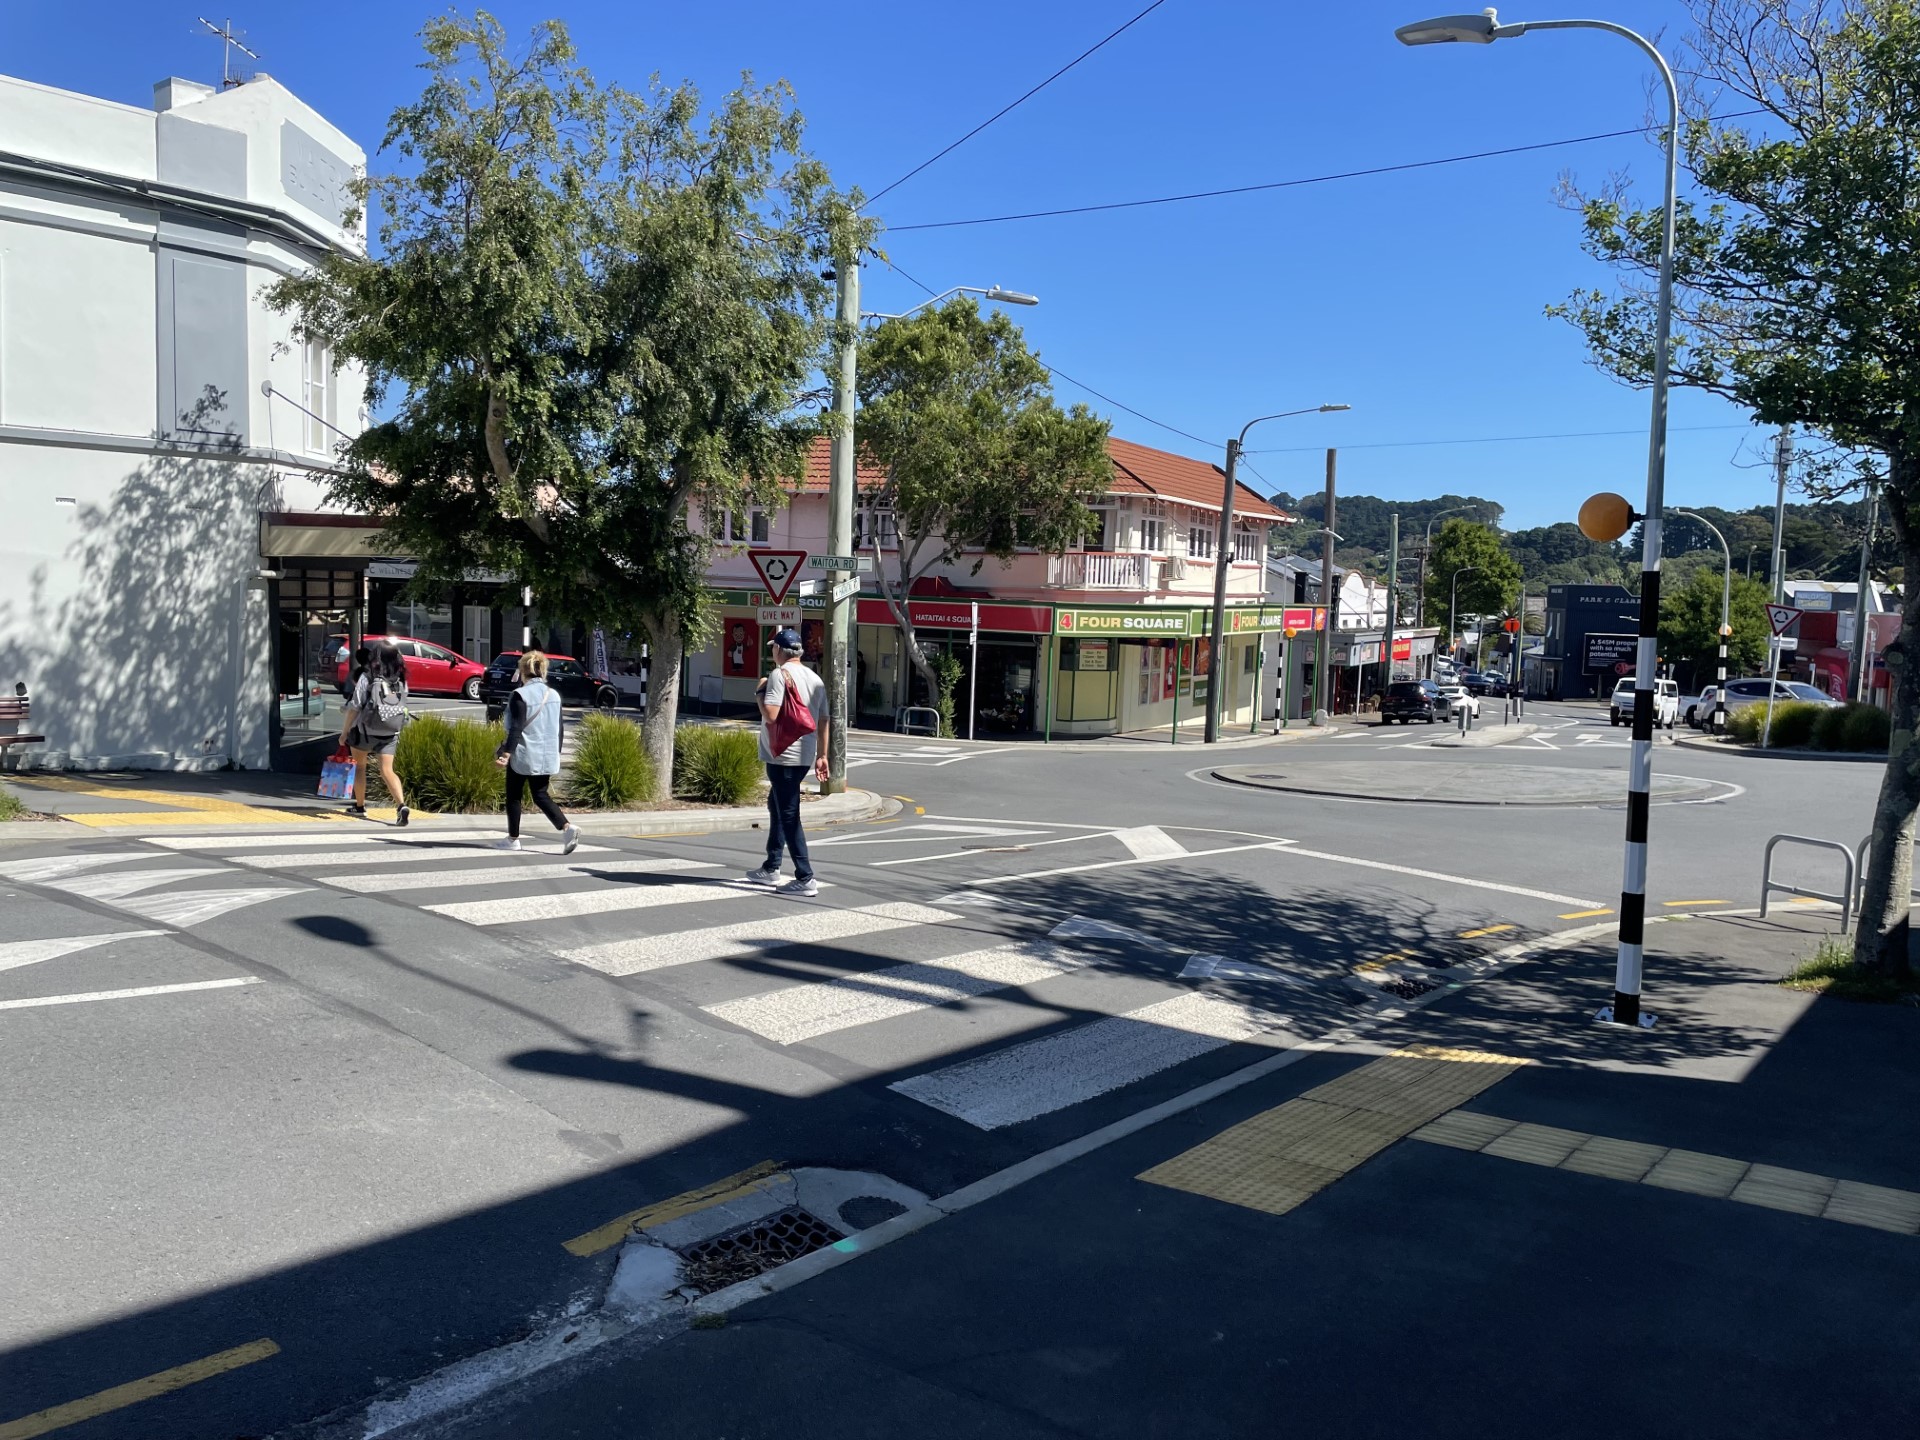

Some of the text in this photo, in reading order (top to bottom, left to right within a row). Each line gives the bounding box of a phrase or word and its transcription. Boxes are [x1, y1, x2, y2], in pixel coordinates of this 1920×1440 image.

[811, 557, 854, 569] WAITOA RD
[765, 596, 797, 606] FUR
[762, 611, 795, 620] GIVE WAY
[915, 614, 945, 622] HATAITAI
[951, 616, 981, 624] SQUAE
[1241, 615, 1258, 627] FOUR
[1060, 614, 1072, 630] 4
[1080, 617, 1183, 629] FOUR SQUARE
